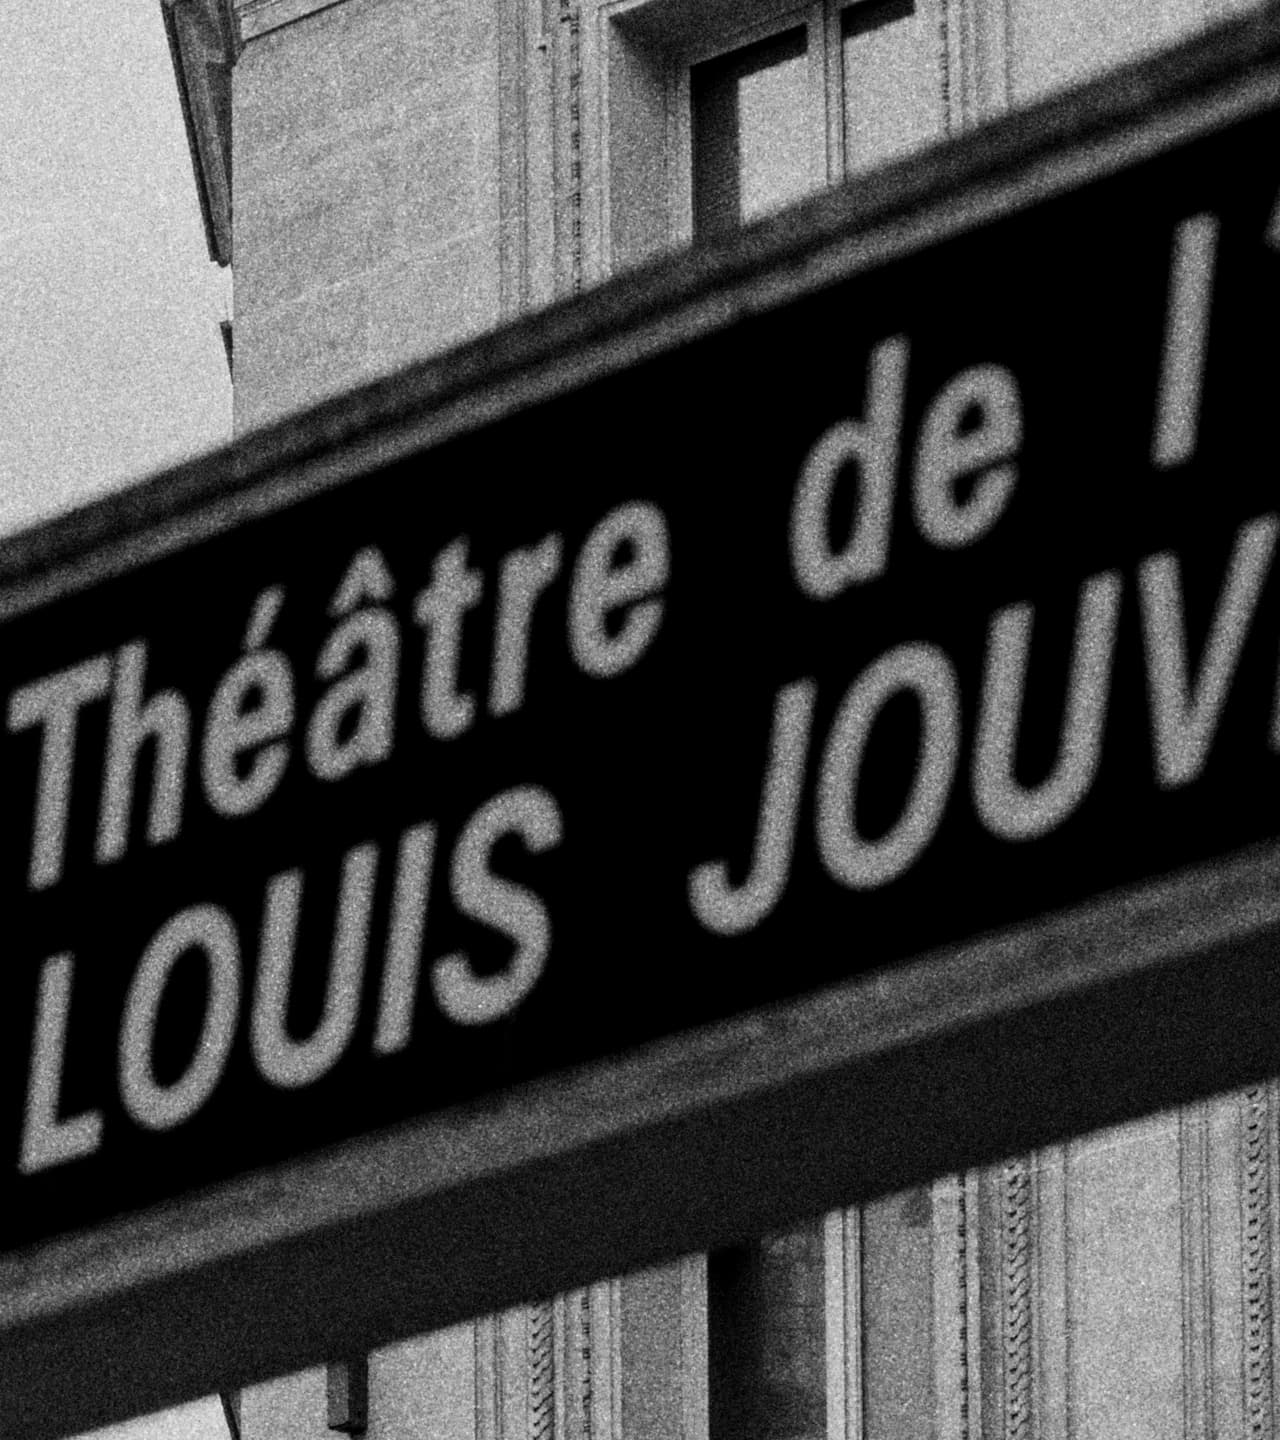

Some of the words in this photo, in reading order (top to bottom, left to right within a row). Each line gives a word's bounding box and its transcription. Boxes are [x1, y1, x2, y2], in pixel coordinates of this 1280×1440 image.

[7, 500, 672, 890] Théâtre
[787, 333, 1025, 600] de
[18, 783, 565, 1176] LOUIS
[687, 514, 1280, 937] JOUV
